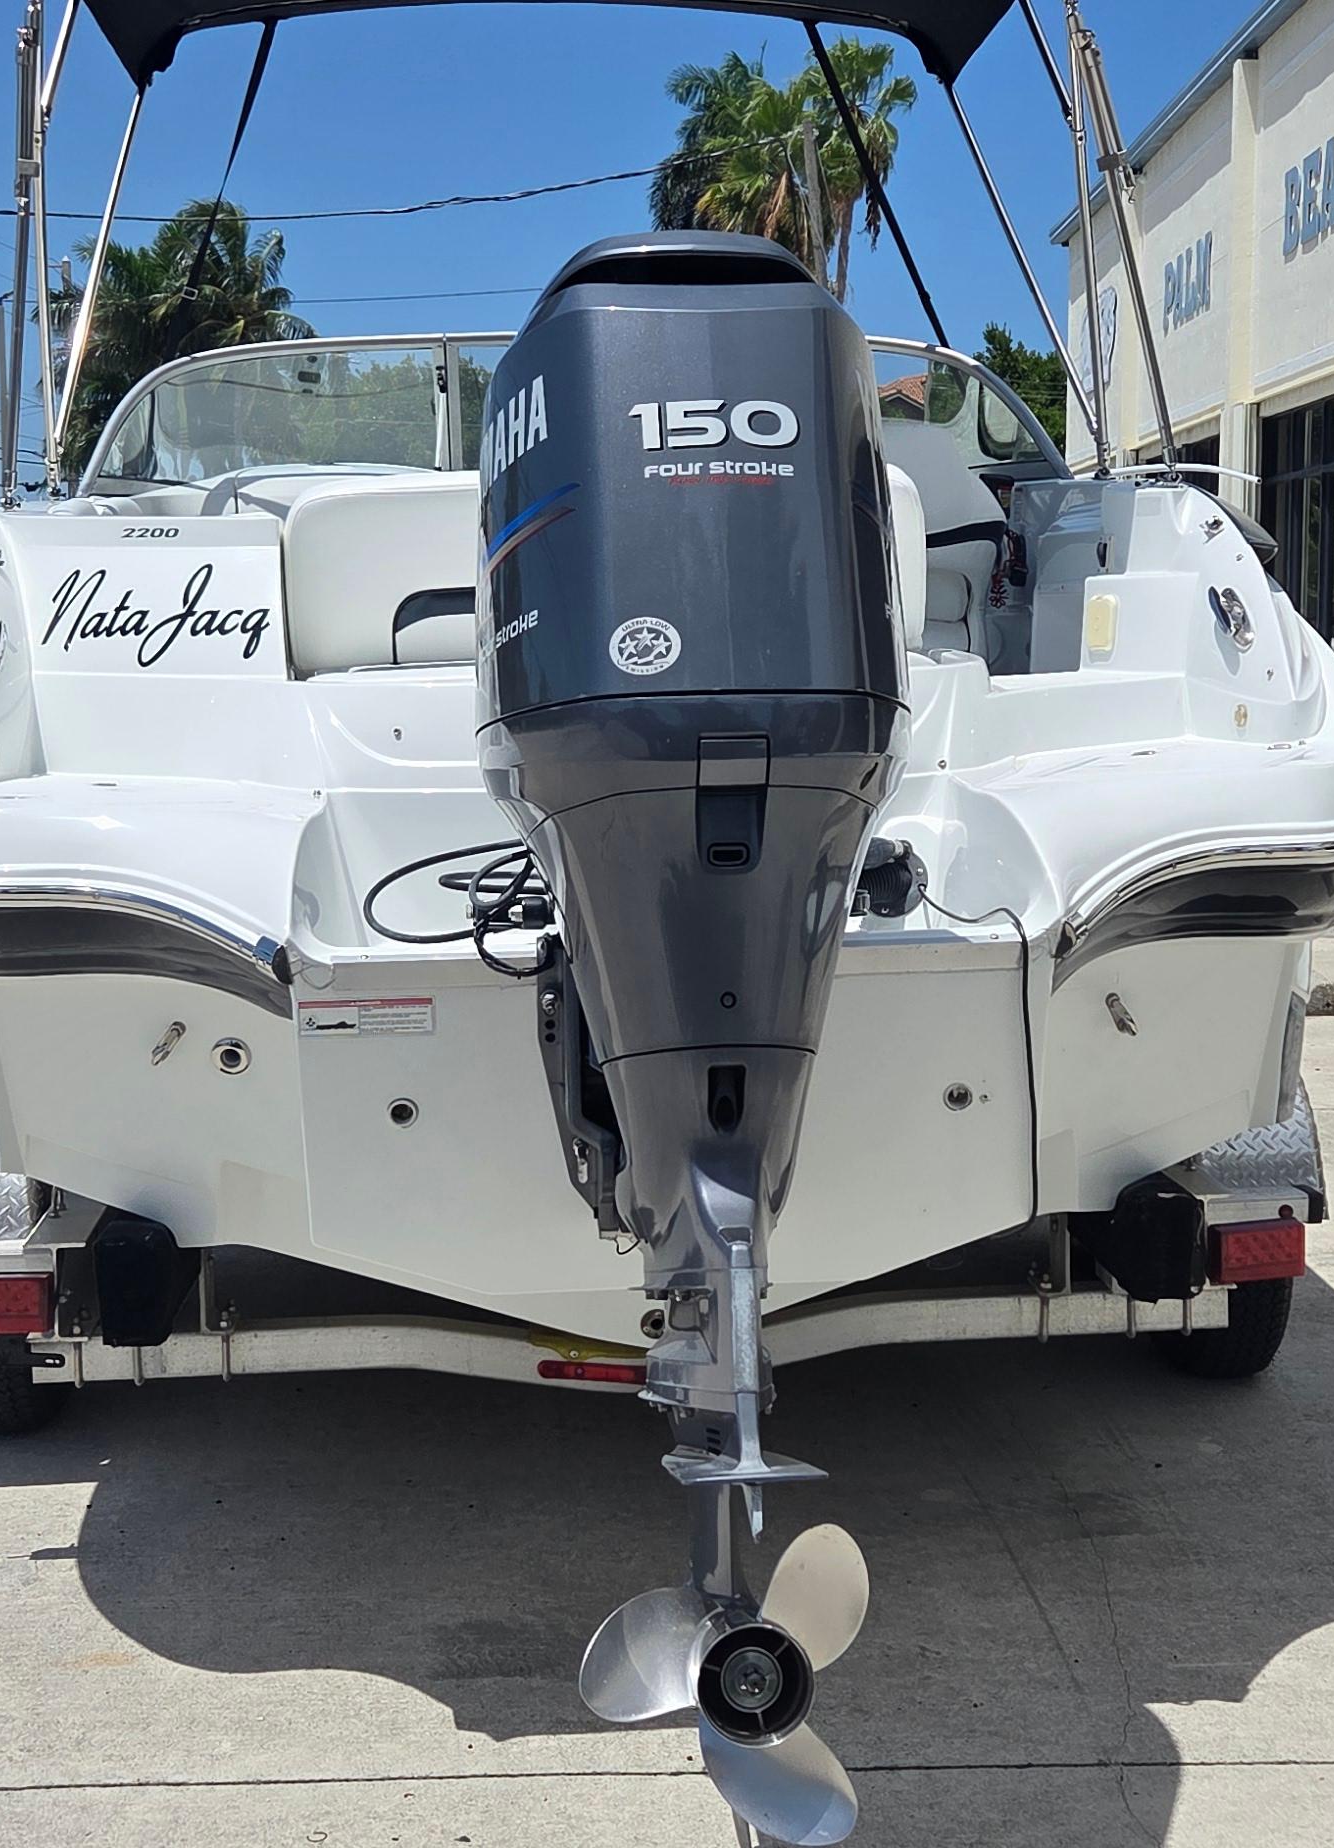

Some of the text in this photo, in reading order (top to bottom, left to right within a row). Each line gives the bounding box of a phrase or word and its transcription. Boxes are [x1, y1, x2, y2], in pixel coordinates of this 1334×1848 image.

[1164, 231, 1212, 329] PALM
[628, 400, 800, 450] 150
[121, 527, 179, 538] 2200
[622, 620, 671, 632] ULTRA LOW
